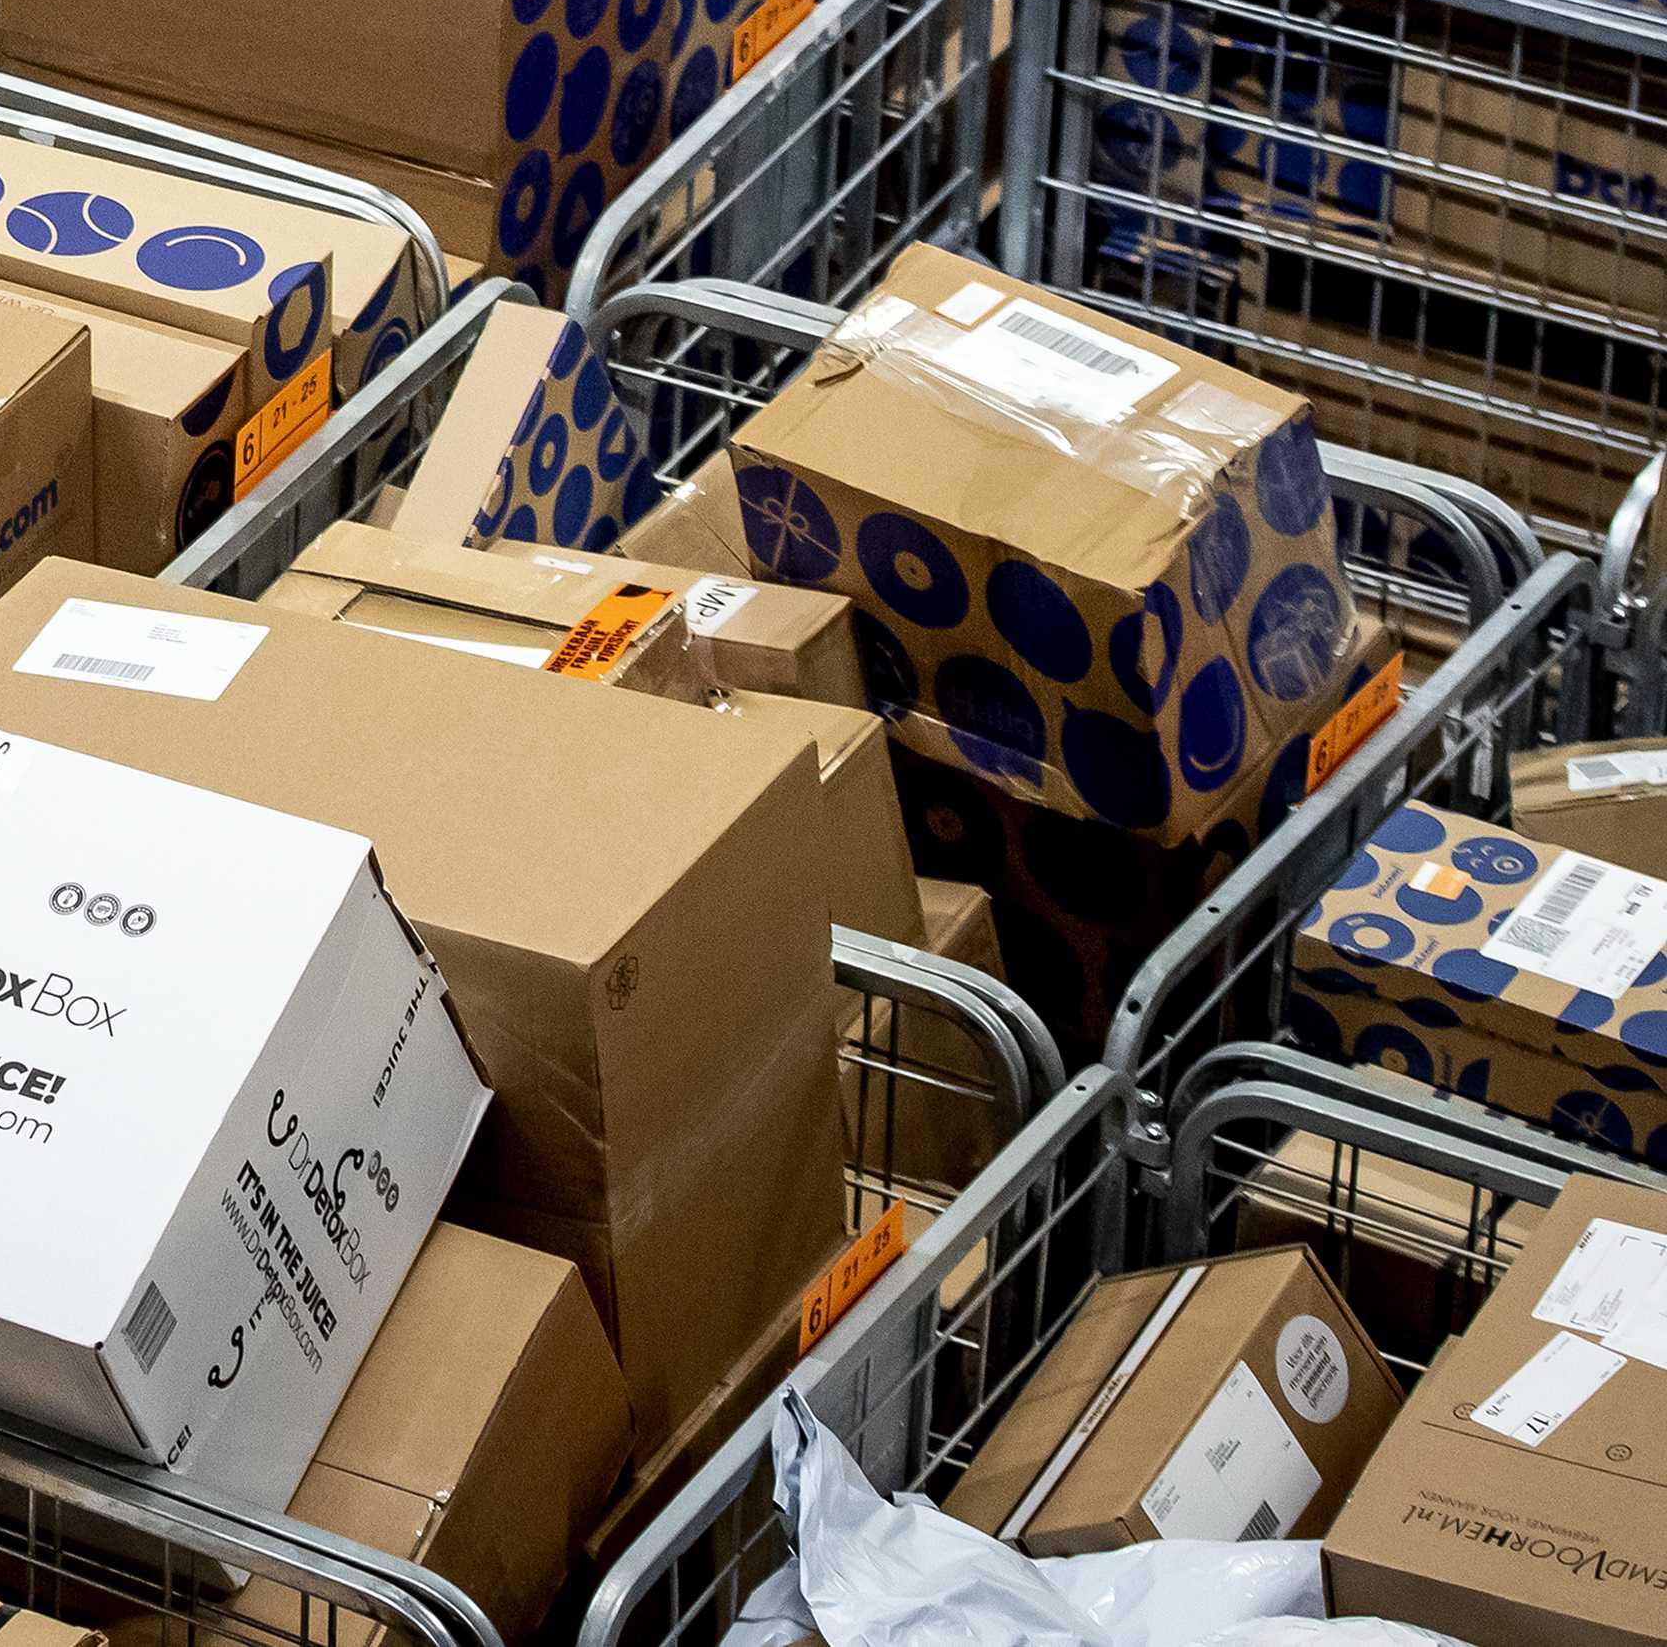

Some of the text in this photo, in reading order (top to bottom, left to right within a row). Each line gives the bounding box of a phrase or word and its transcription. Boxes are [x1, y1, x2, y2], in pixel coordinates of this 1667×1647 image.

[273, 376, 318, 428] 21 25
[241, 439, 256, 466] 6
[571, 629, 610, 670] FRAGILE
[403, 974, 430, 1029] THE
[235, 1158, 340, 1342] IT'S IN THE JUICE!
[843, 1225, 890, 1290] 21 25
[808, 1306, 823, 1334] 6
[1526, 1416, 1549, 1435] 17
